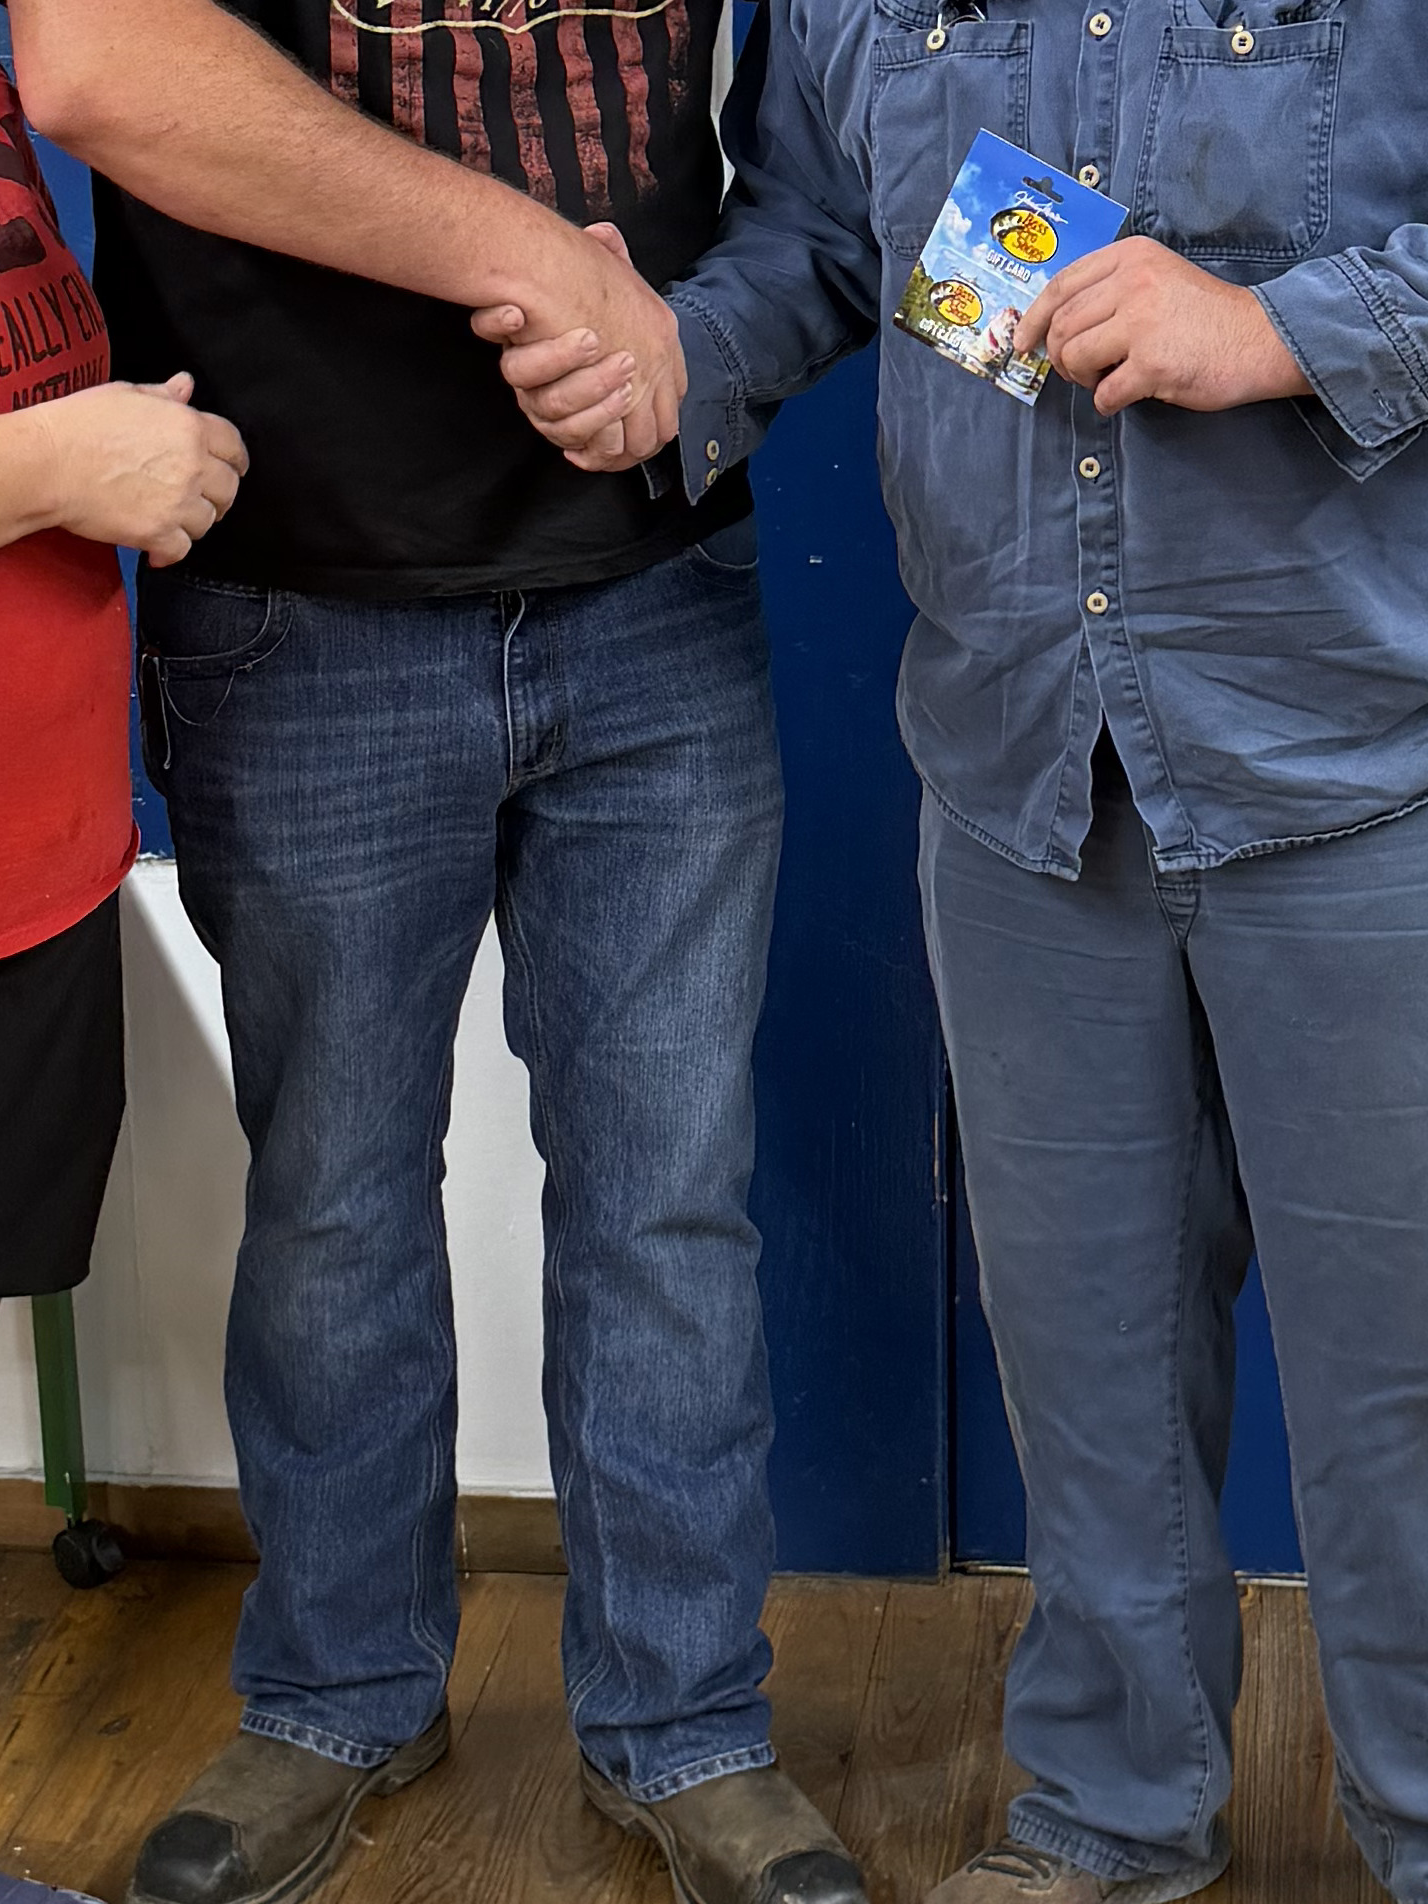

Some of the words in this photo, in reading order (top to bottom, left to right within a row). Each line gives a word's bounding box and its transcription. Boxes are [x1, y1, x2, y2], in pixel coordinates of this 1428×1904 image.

[1022, 213, 1049, 236] Bass
[987, 249, 1008, 271] GIFT
[1005, 261, 1033, 283] CARD
